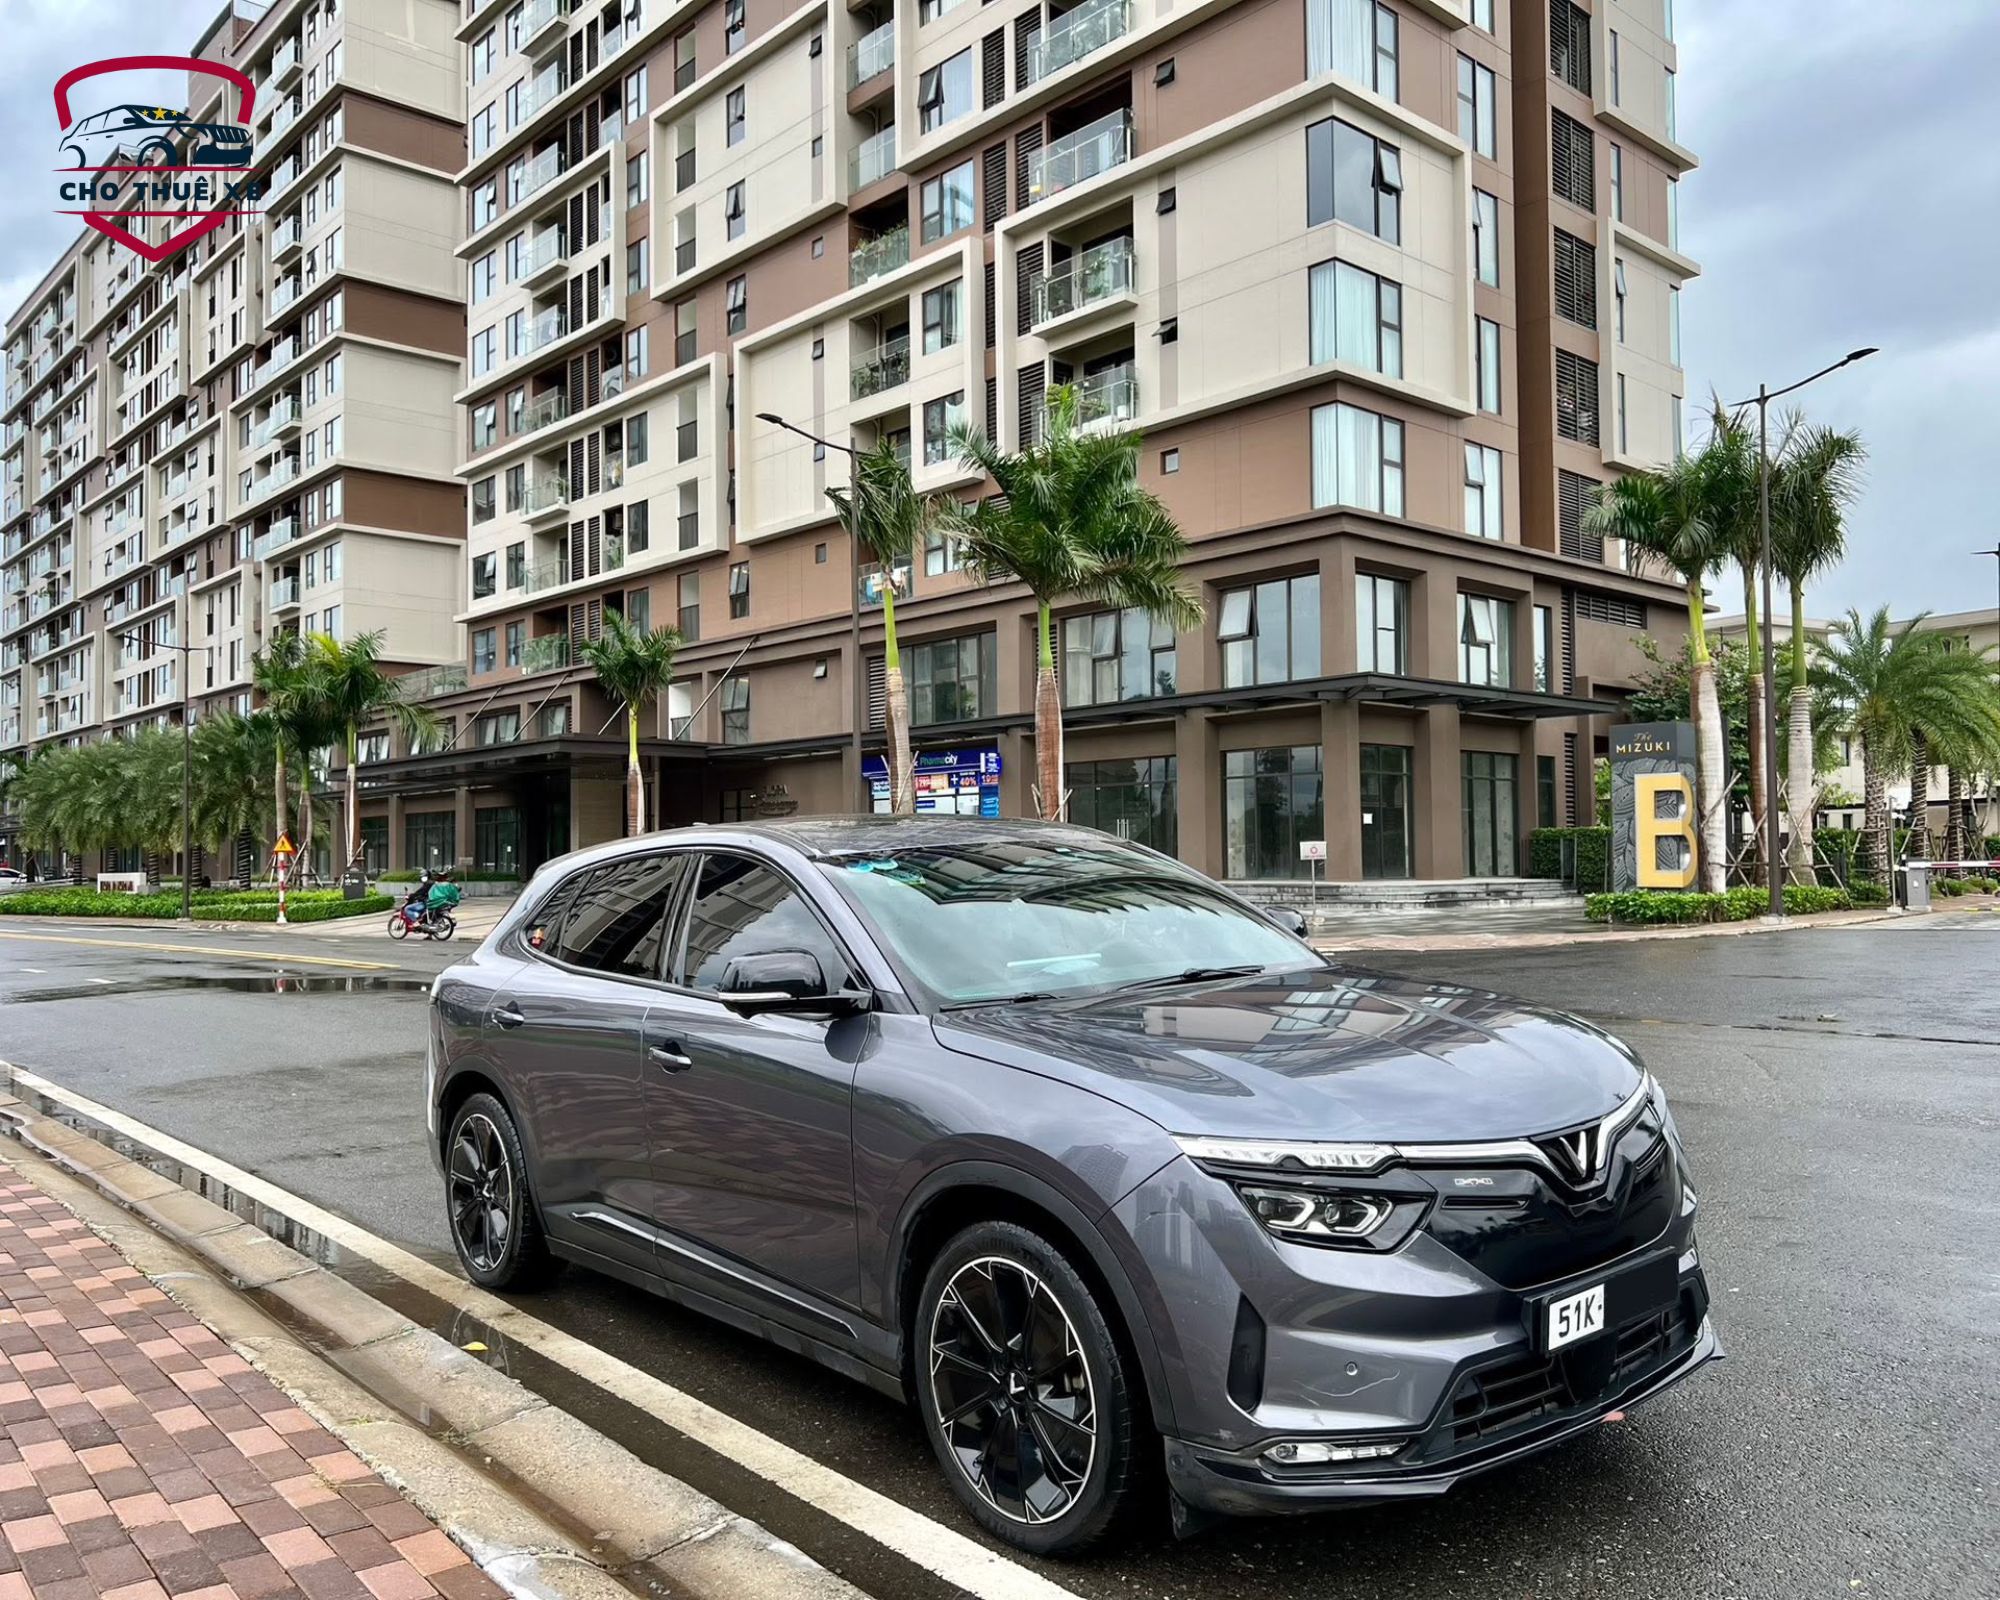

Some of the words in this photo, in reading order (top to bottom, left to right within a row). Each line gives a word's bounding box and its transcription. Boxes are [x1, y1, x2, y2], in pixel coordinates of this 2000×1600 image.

[1633, 732, 1652, 743] The
[1616, 741, 1670, 753] MIZUKI
[1634, 772, 1698, 889] B
